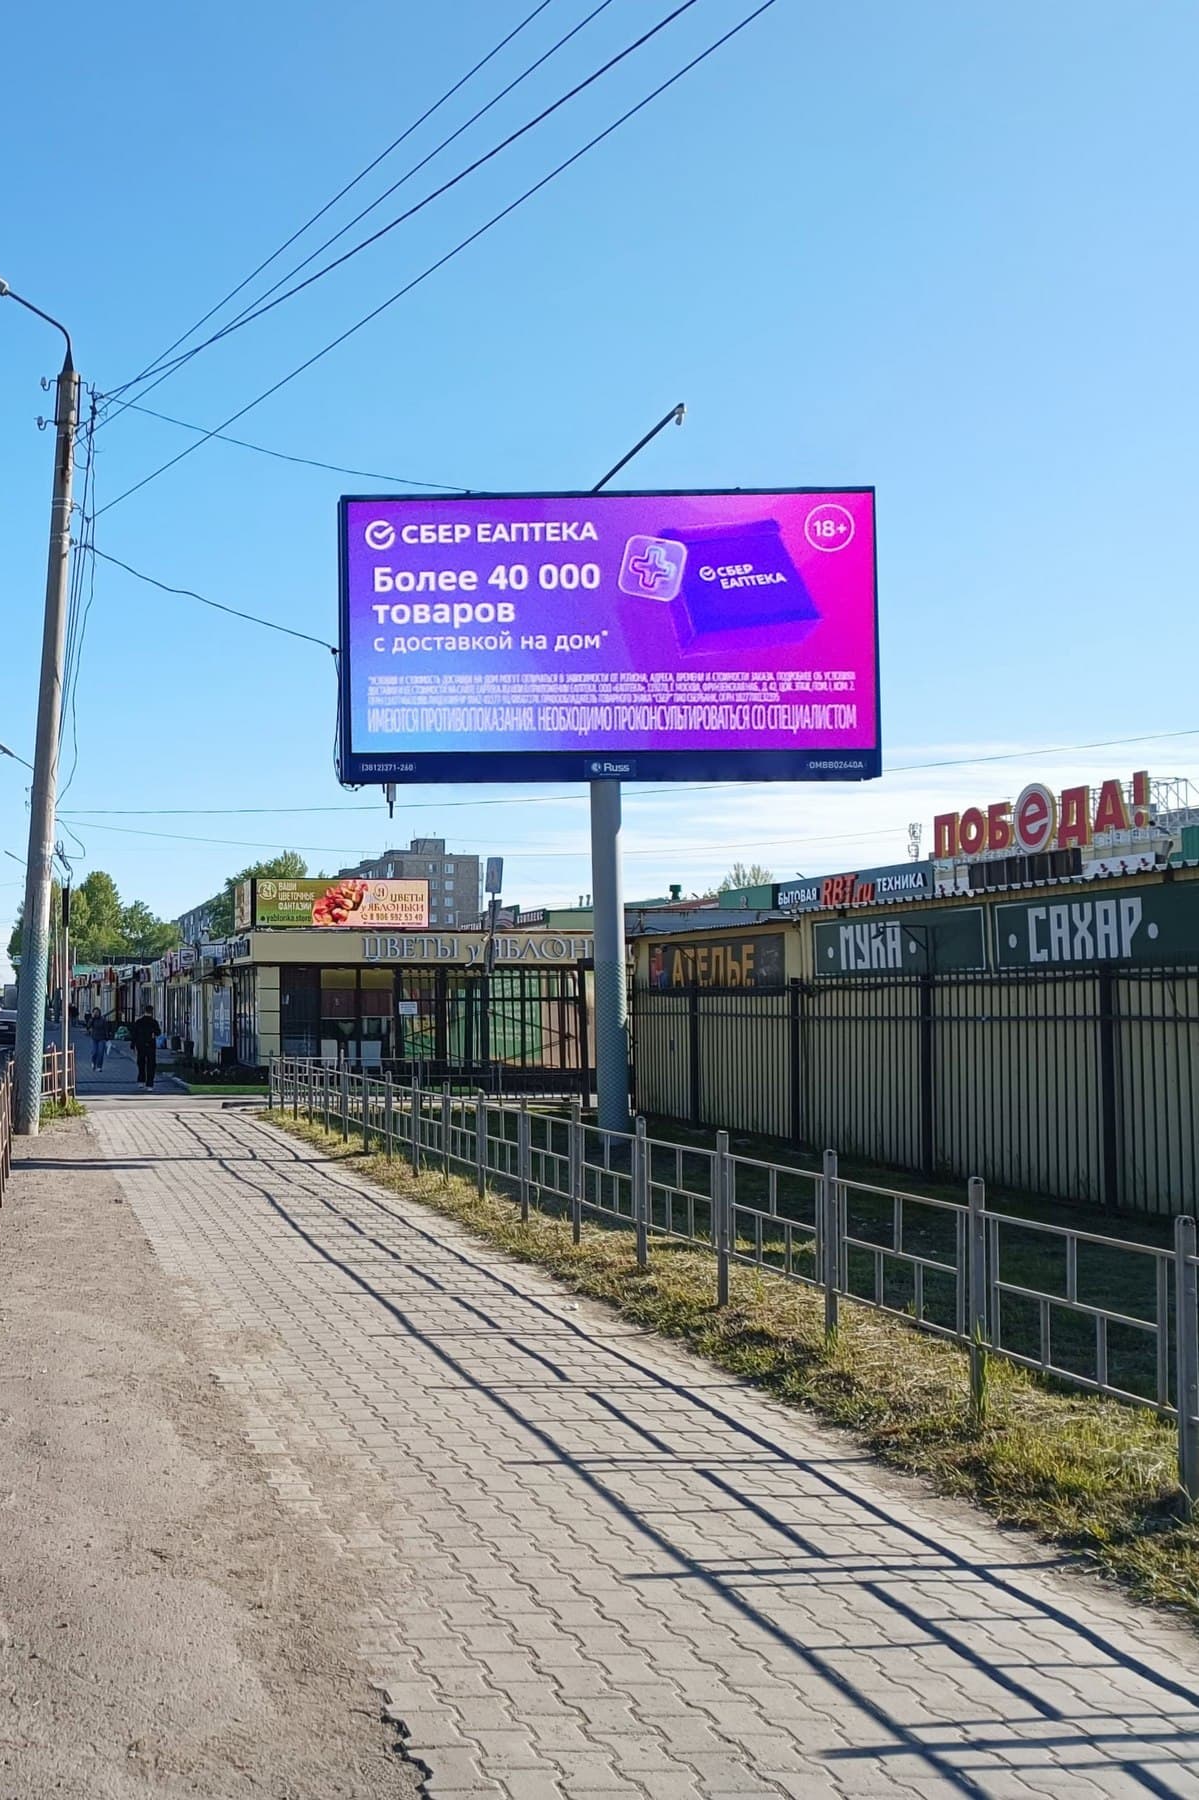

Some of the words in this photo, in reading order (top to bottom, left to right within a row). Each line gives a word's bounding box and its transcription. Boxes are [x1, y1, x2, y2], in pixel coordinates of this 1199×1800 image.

[401, 523, 472, 545] СБЕР
[476, 521, 599, 543] ЕАПТЕКА
[812, 520, 848, 537] 18+
[373, 566, 479, 592] Более
[487, 564, 529, 591] 40
[538, 563, 601, 590] 000
[717, 563, 753, 578] СБЕР
[720, 571, 788, 590] ЕАПТЕКА
[372, 602, 516, 629] товаров
[373, 636, 385, 652] с
[392, 630, 513, 655] доставкой
[521, 634, 548, 651] на
[368, 707, 419, 733] ИМЕЮТСЯ
[537, 705, 612, 736] НЕОБХОДИМО
[613, 704, 750, 731] ПРОКОНСУЛЬТИРОВАТЬСЯ
[751, 704, 766, 730] СО
[766, 703, 857, 735] СПЕЦИАЛИСТОМ
[603, 762, 630, 773] Russ
[390, 894, 424, 904] ЦВЕТЫ
[778, 888, 817, 906] БЫТОВАЯ
[876, 871, 925, 893] ТЕХНИКА
[1027, 897, 1142, 963] САХАР
[362, 936, 460, 962] ЦВЕТЫ
[839, 921, 901, 970] МУКА
[672, 944, 755, 988] АТЕЛЬЕ
